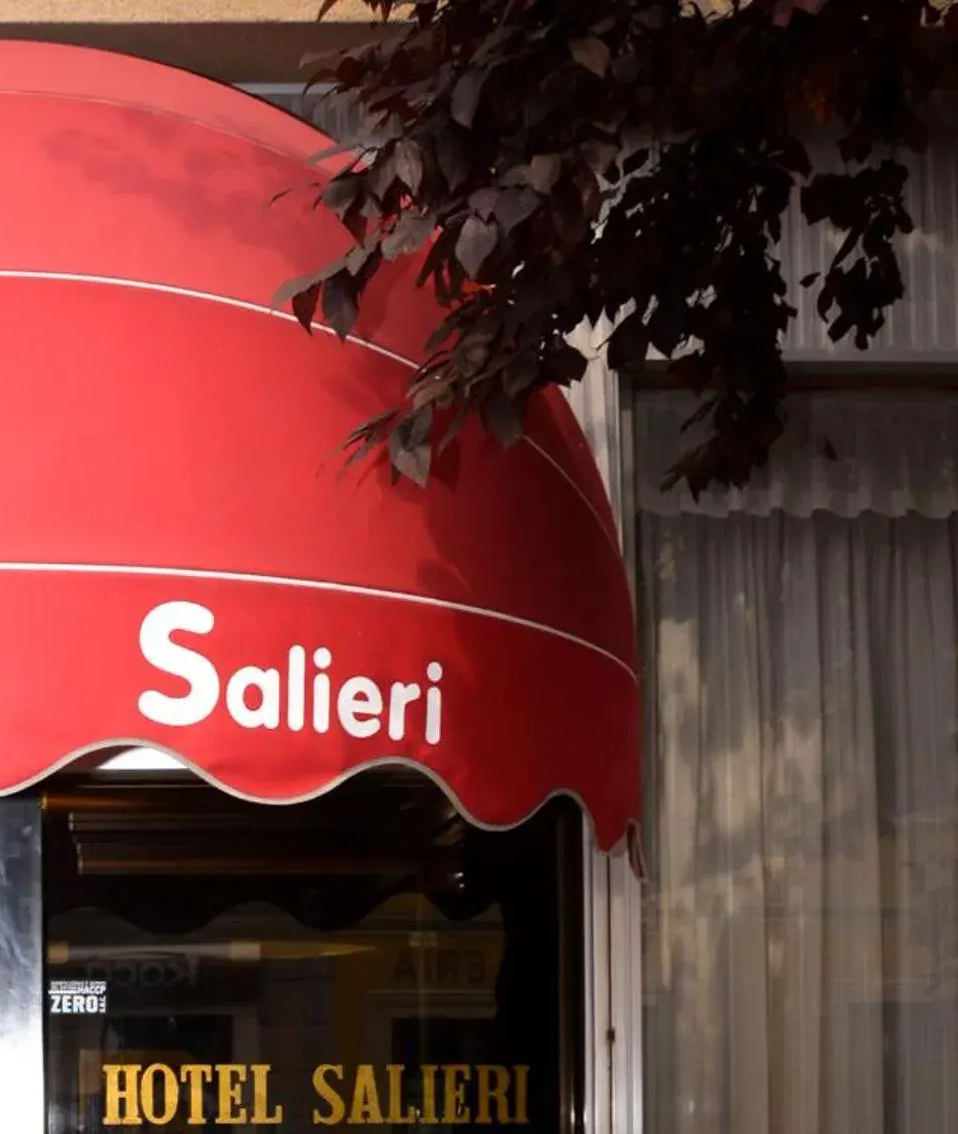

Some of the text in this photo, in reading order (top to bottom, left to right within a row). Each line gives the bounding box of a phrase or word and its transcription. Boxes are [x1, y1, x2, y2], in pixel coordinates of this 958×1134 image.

[138, 600, 443, 745] Salieri
[50, 994, 99, 1014] ZERO
[102, 1063, 531, 1126] HOTEL SALIERI
